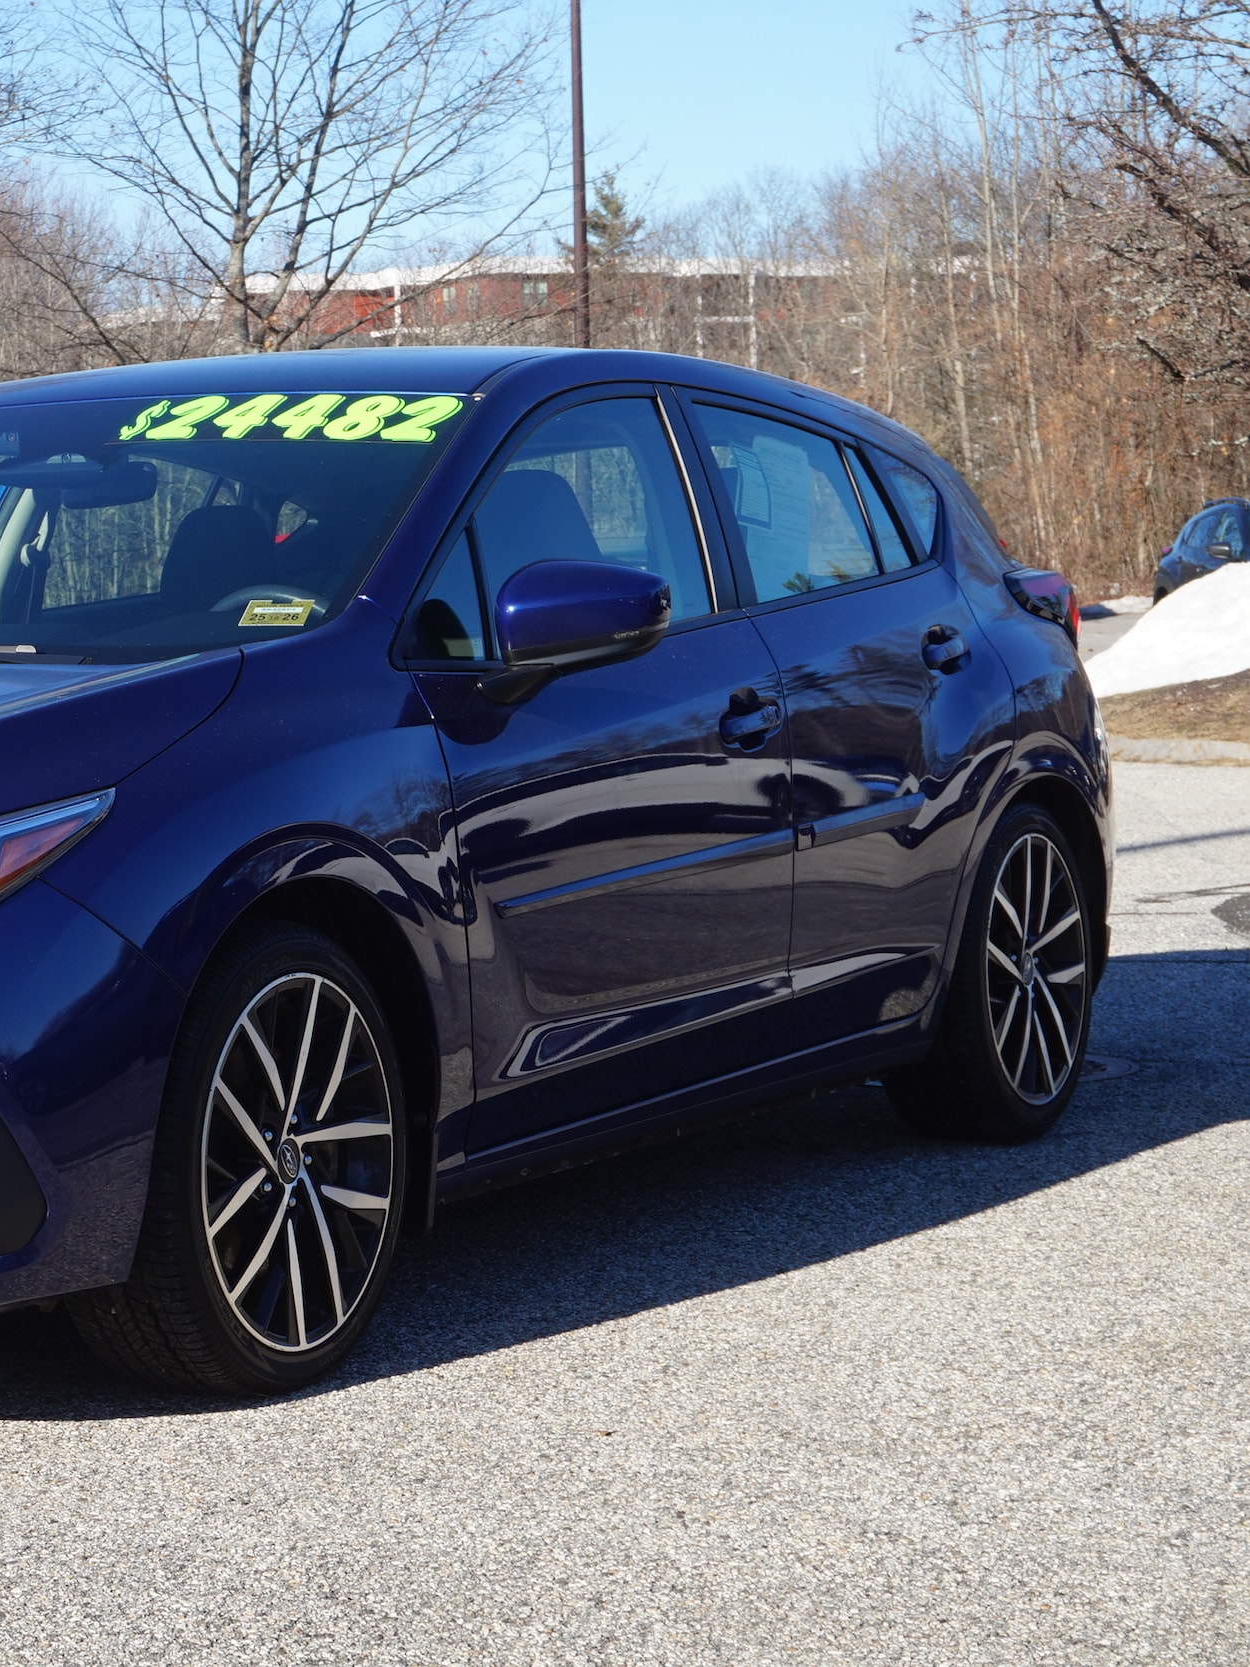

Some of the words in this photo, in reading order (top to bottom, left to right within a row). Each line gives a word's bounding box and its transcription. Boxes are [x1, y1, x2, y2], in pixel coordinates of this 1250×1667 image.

[118, 394, 463, 442] $24482
[249, 613, 266, 621] 25
[282, 613, 299, 621] 26
